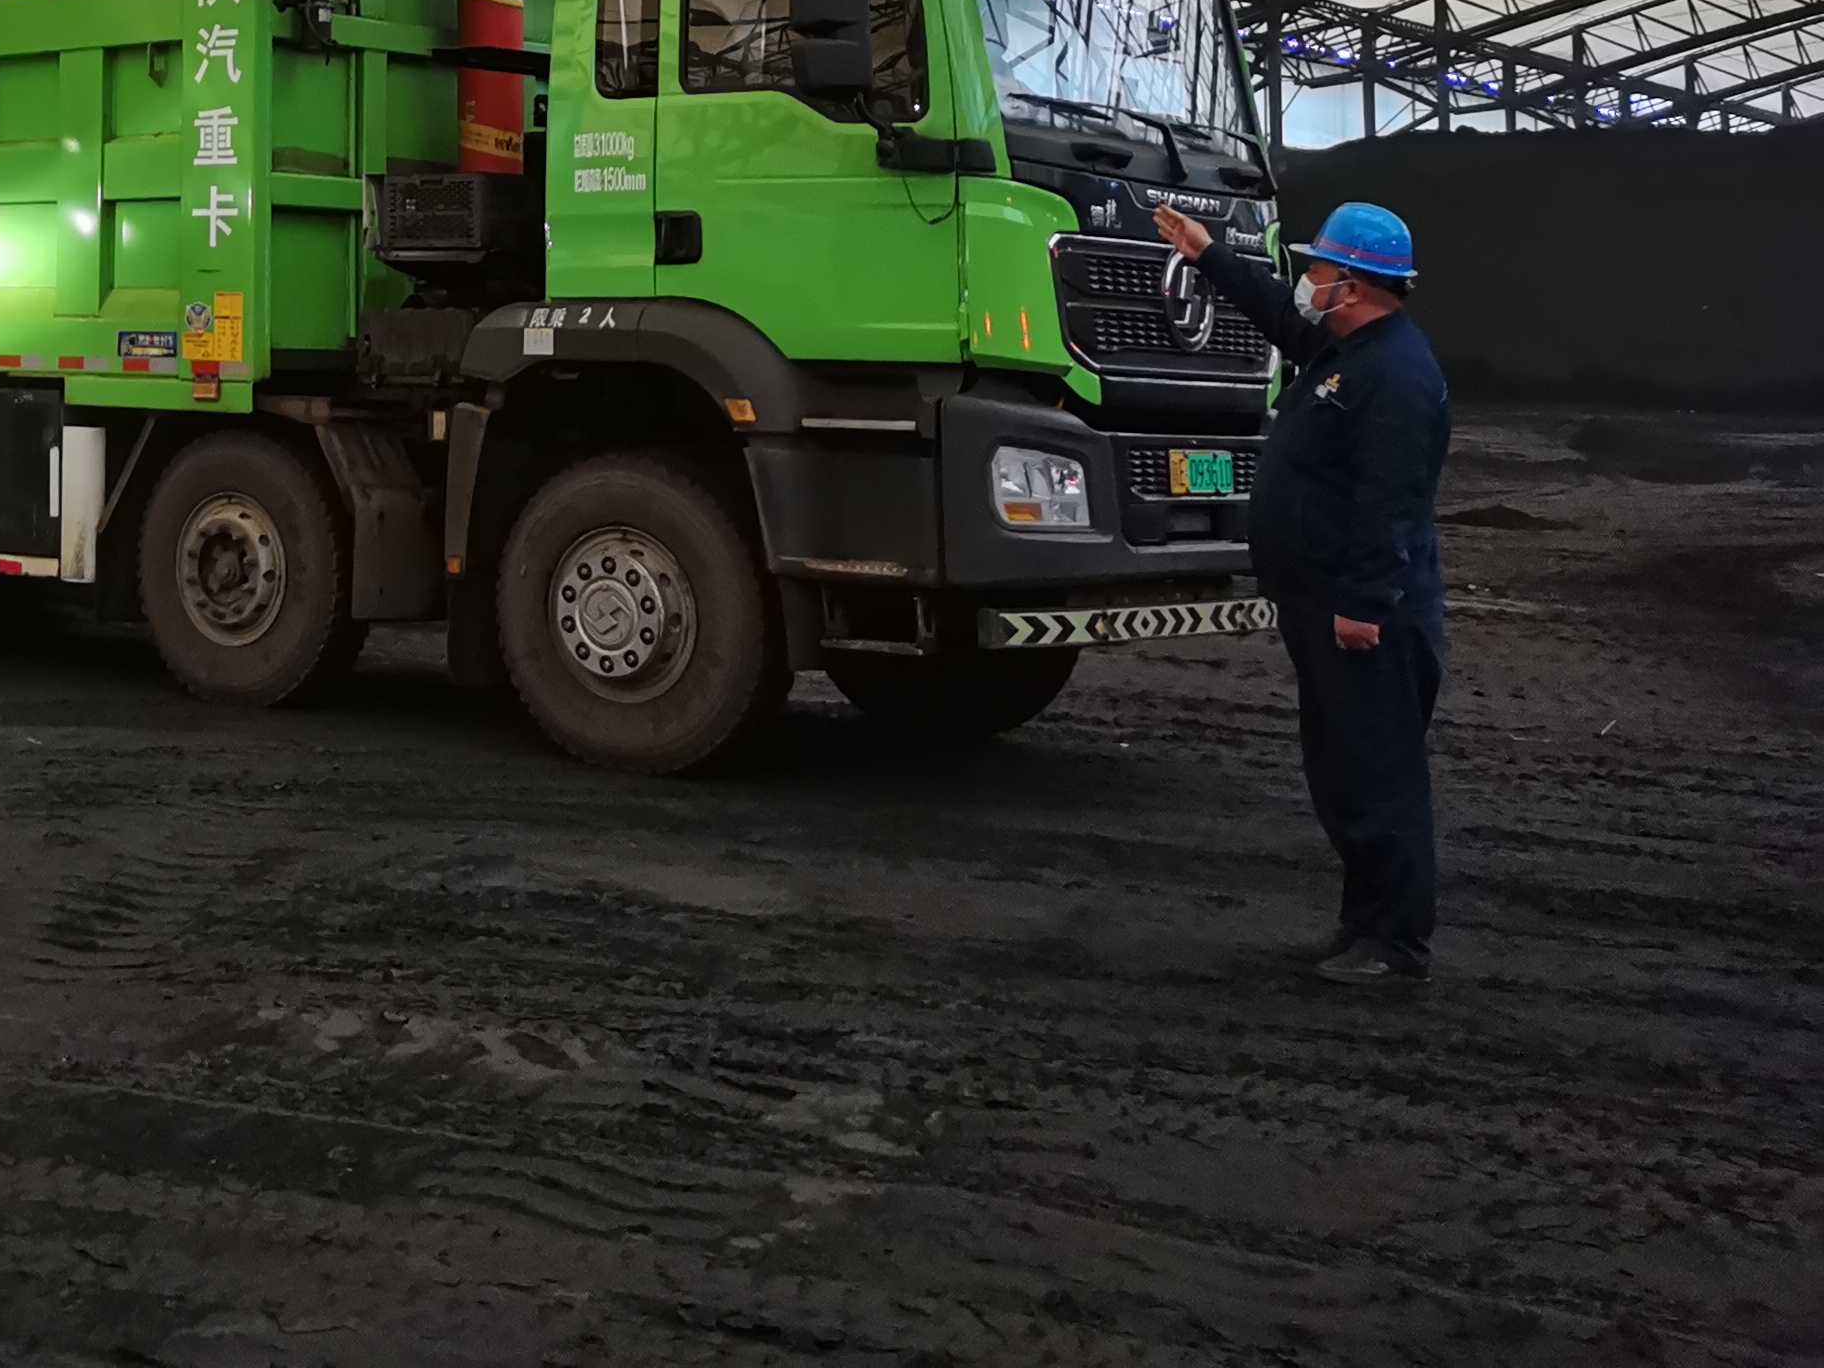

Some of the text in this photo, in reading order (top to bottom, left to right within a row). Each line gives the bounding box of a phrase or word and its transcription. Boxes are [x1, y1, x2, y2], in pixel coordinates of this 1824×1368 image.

[1146, 188, 1220, 213] SHACMAN
[578, 306, 593, 324] 2
[599, 306, 616, 329] 人
